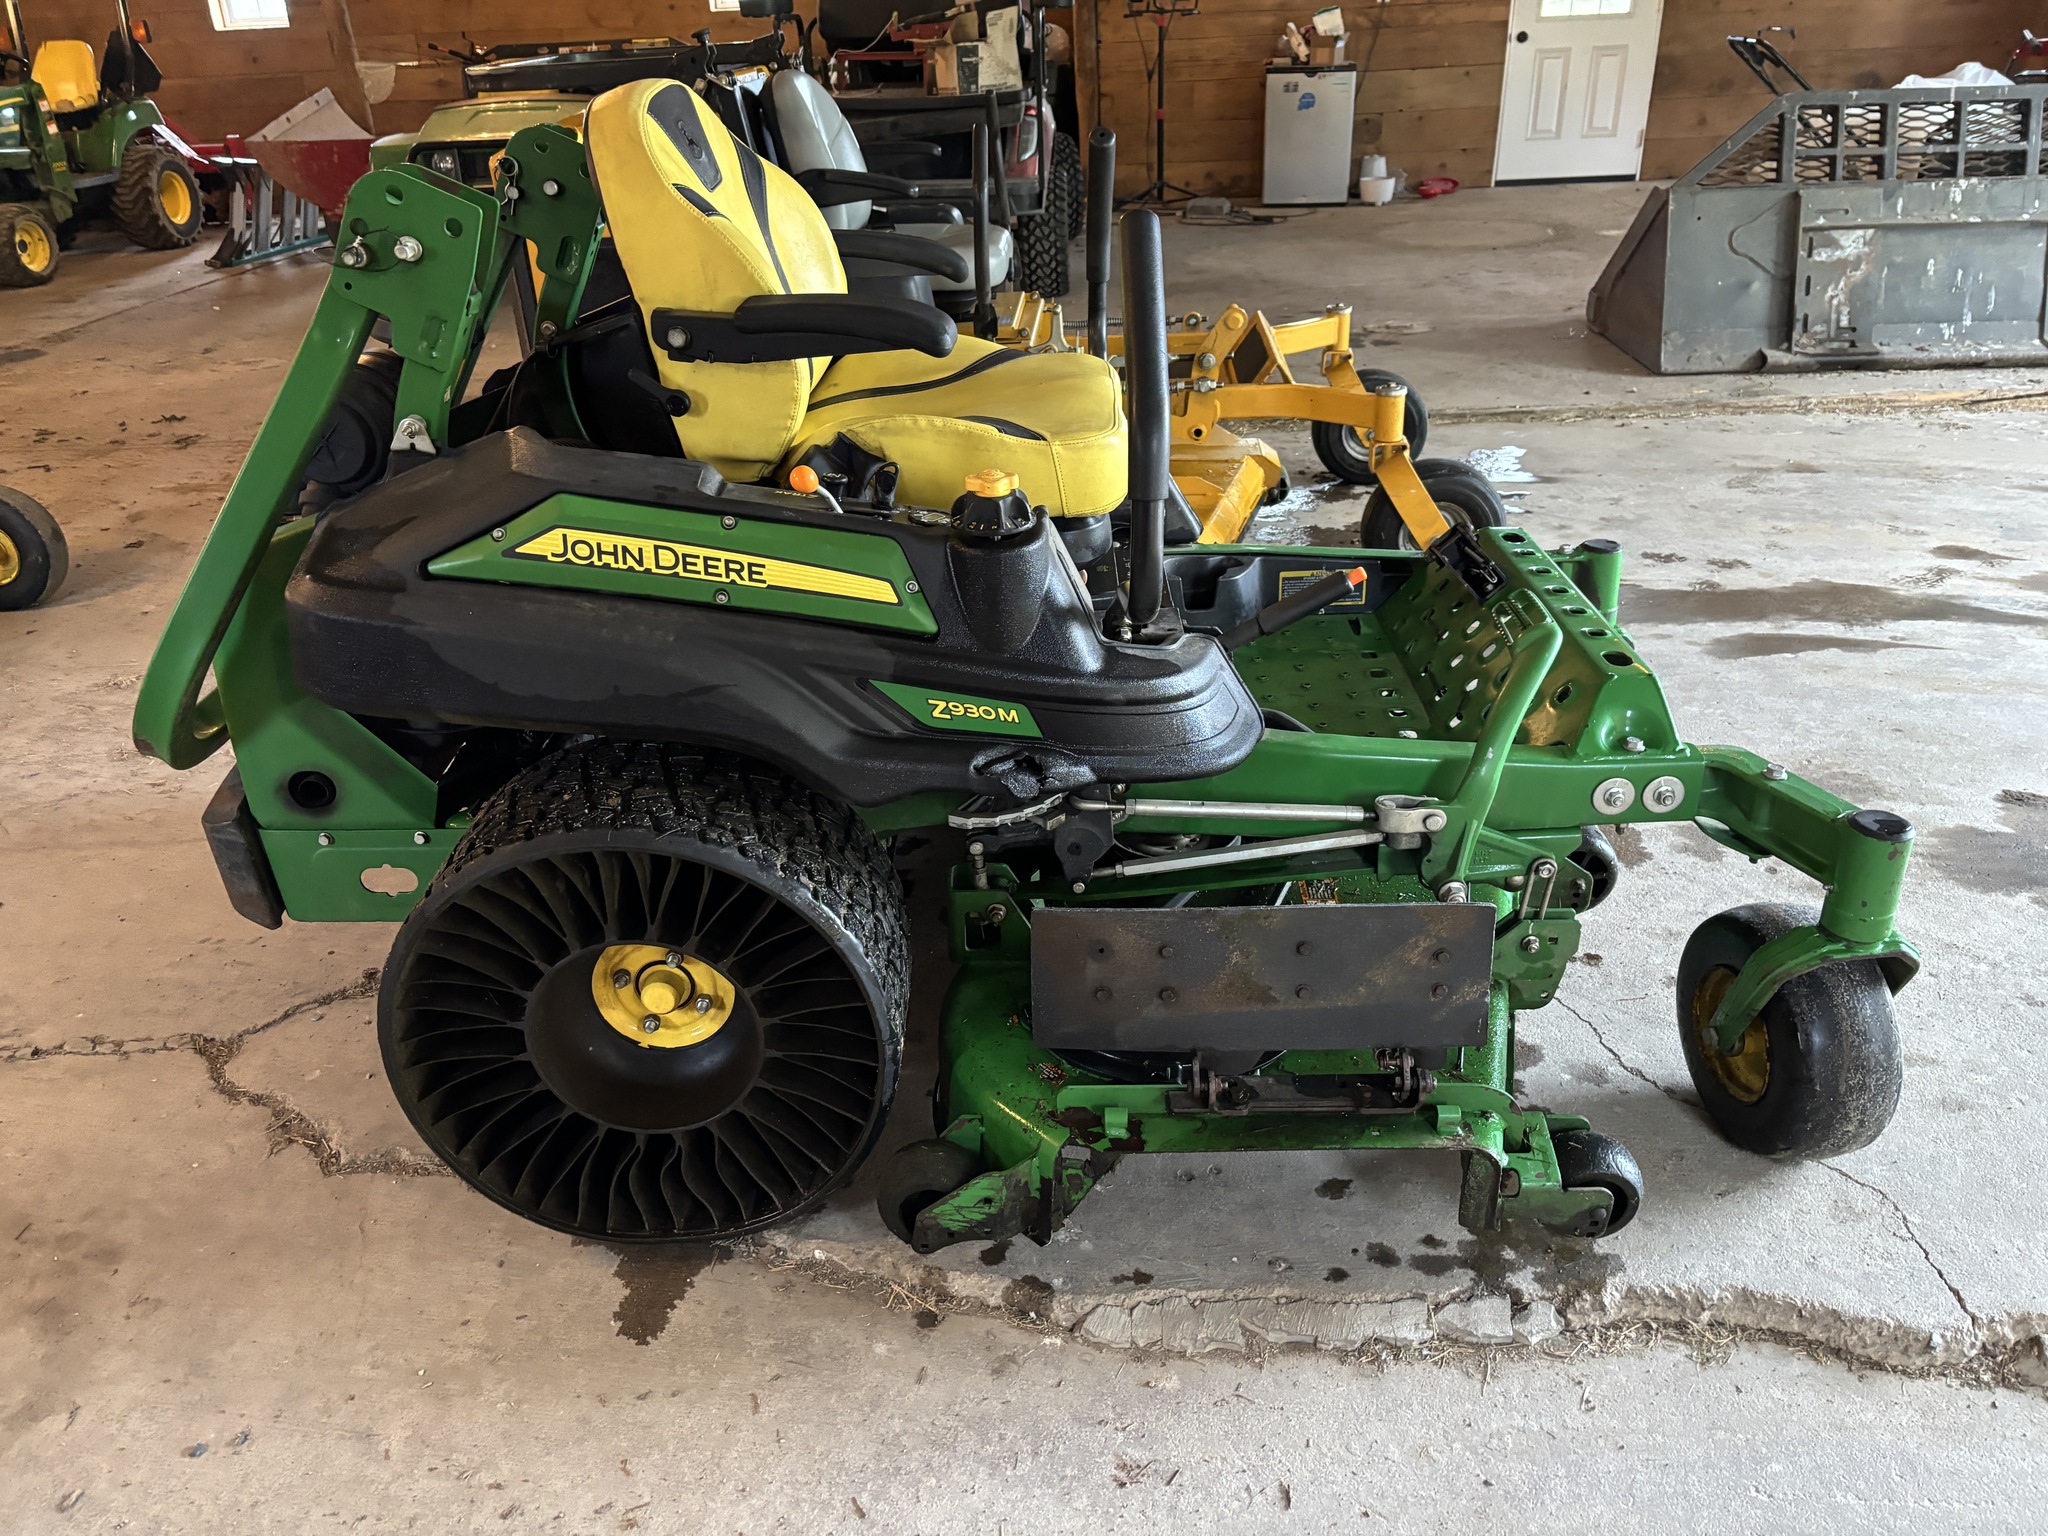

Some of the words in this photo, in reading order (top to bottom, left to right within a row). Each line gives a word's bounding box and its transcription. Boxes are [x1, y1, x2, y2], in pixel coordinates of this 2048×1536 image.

[551, 533, 644, 568] JOHN
[653, 544, 768, 584] DEERE
[926, 698, 1020, 724] Z930M
